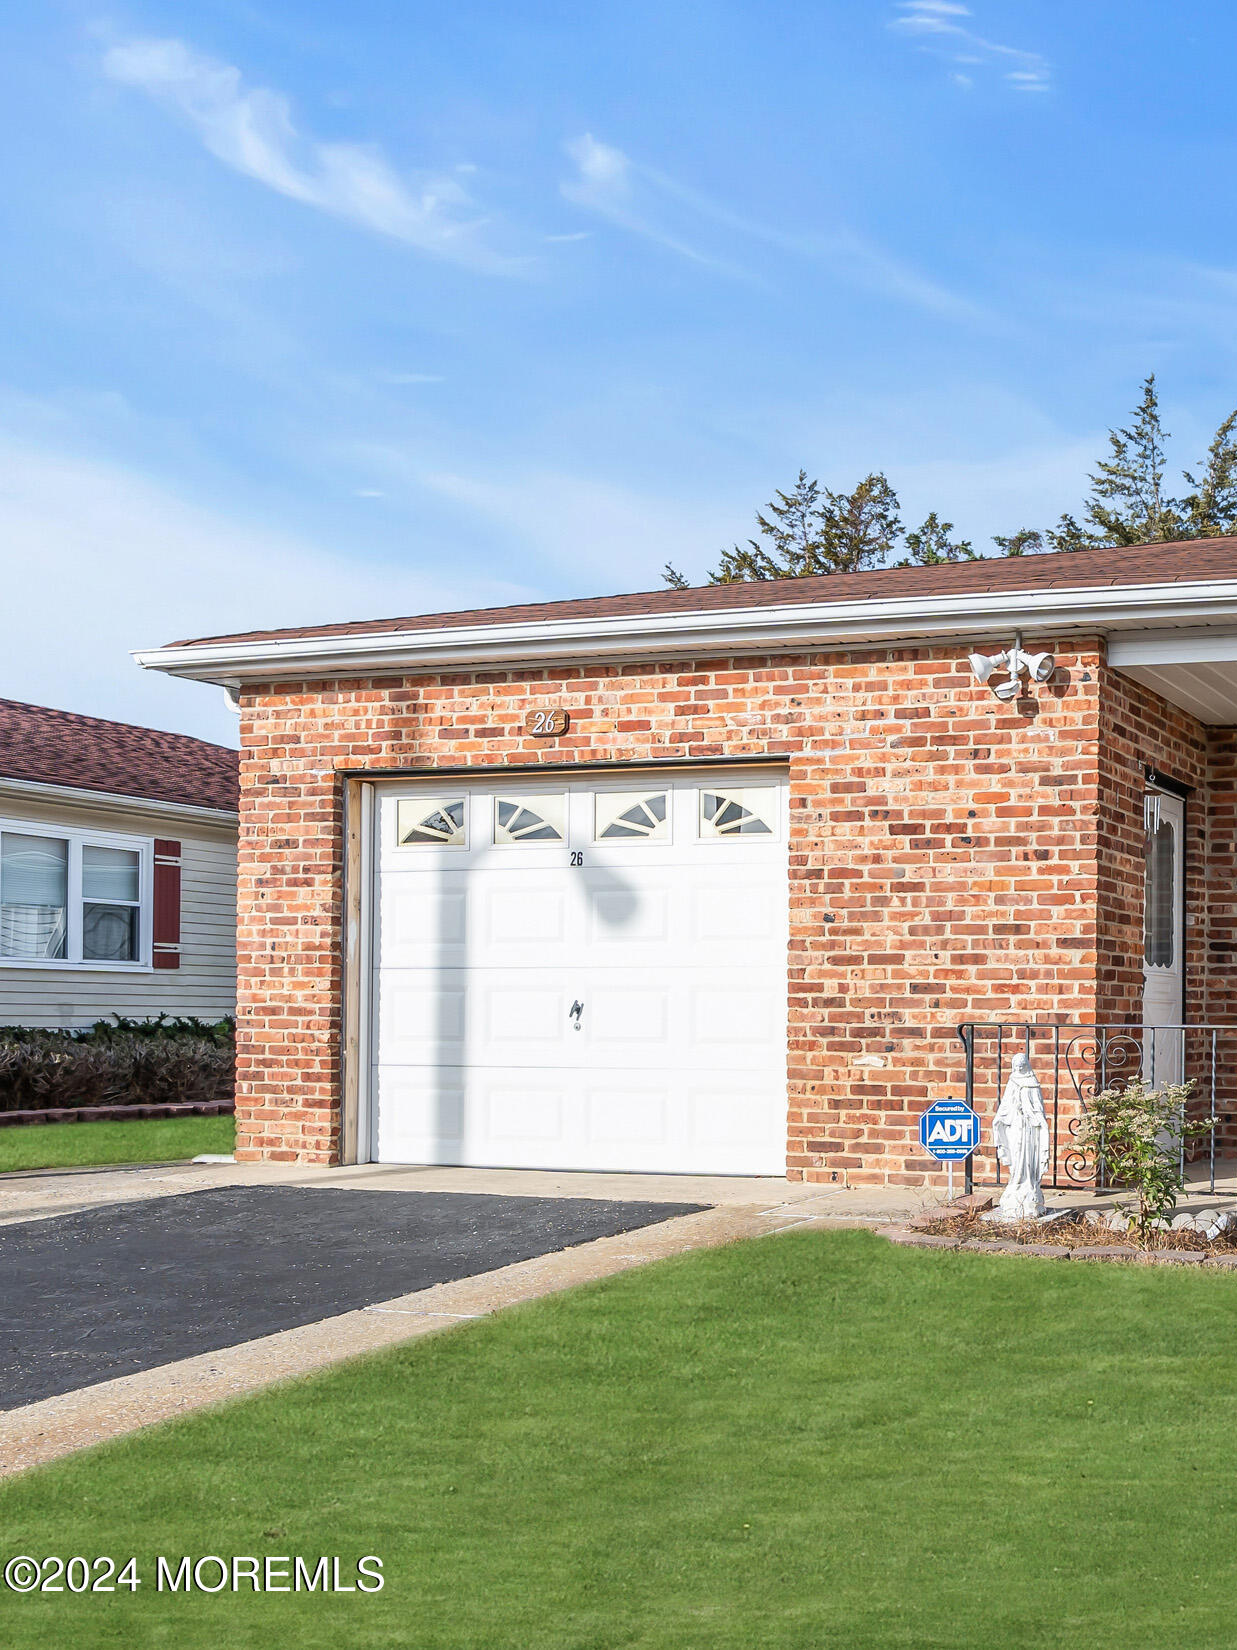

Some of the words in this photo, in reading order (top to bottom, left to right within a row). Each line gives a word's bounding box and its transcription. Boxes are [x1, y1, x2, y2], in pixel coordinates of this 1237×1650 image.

[533, 711, 555, 733] 26
[570, 851, 583, 866] 26
[957, 1105, 965, 1113] by
[928, 1119, 970, 1143] ADT
